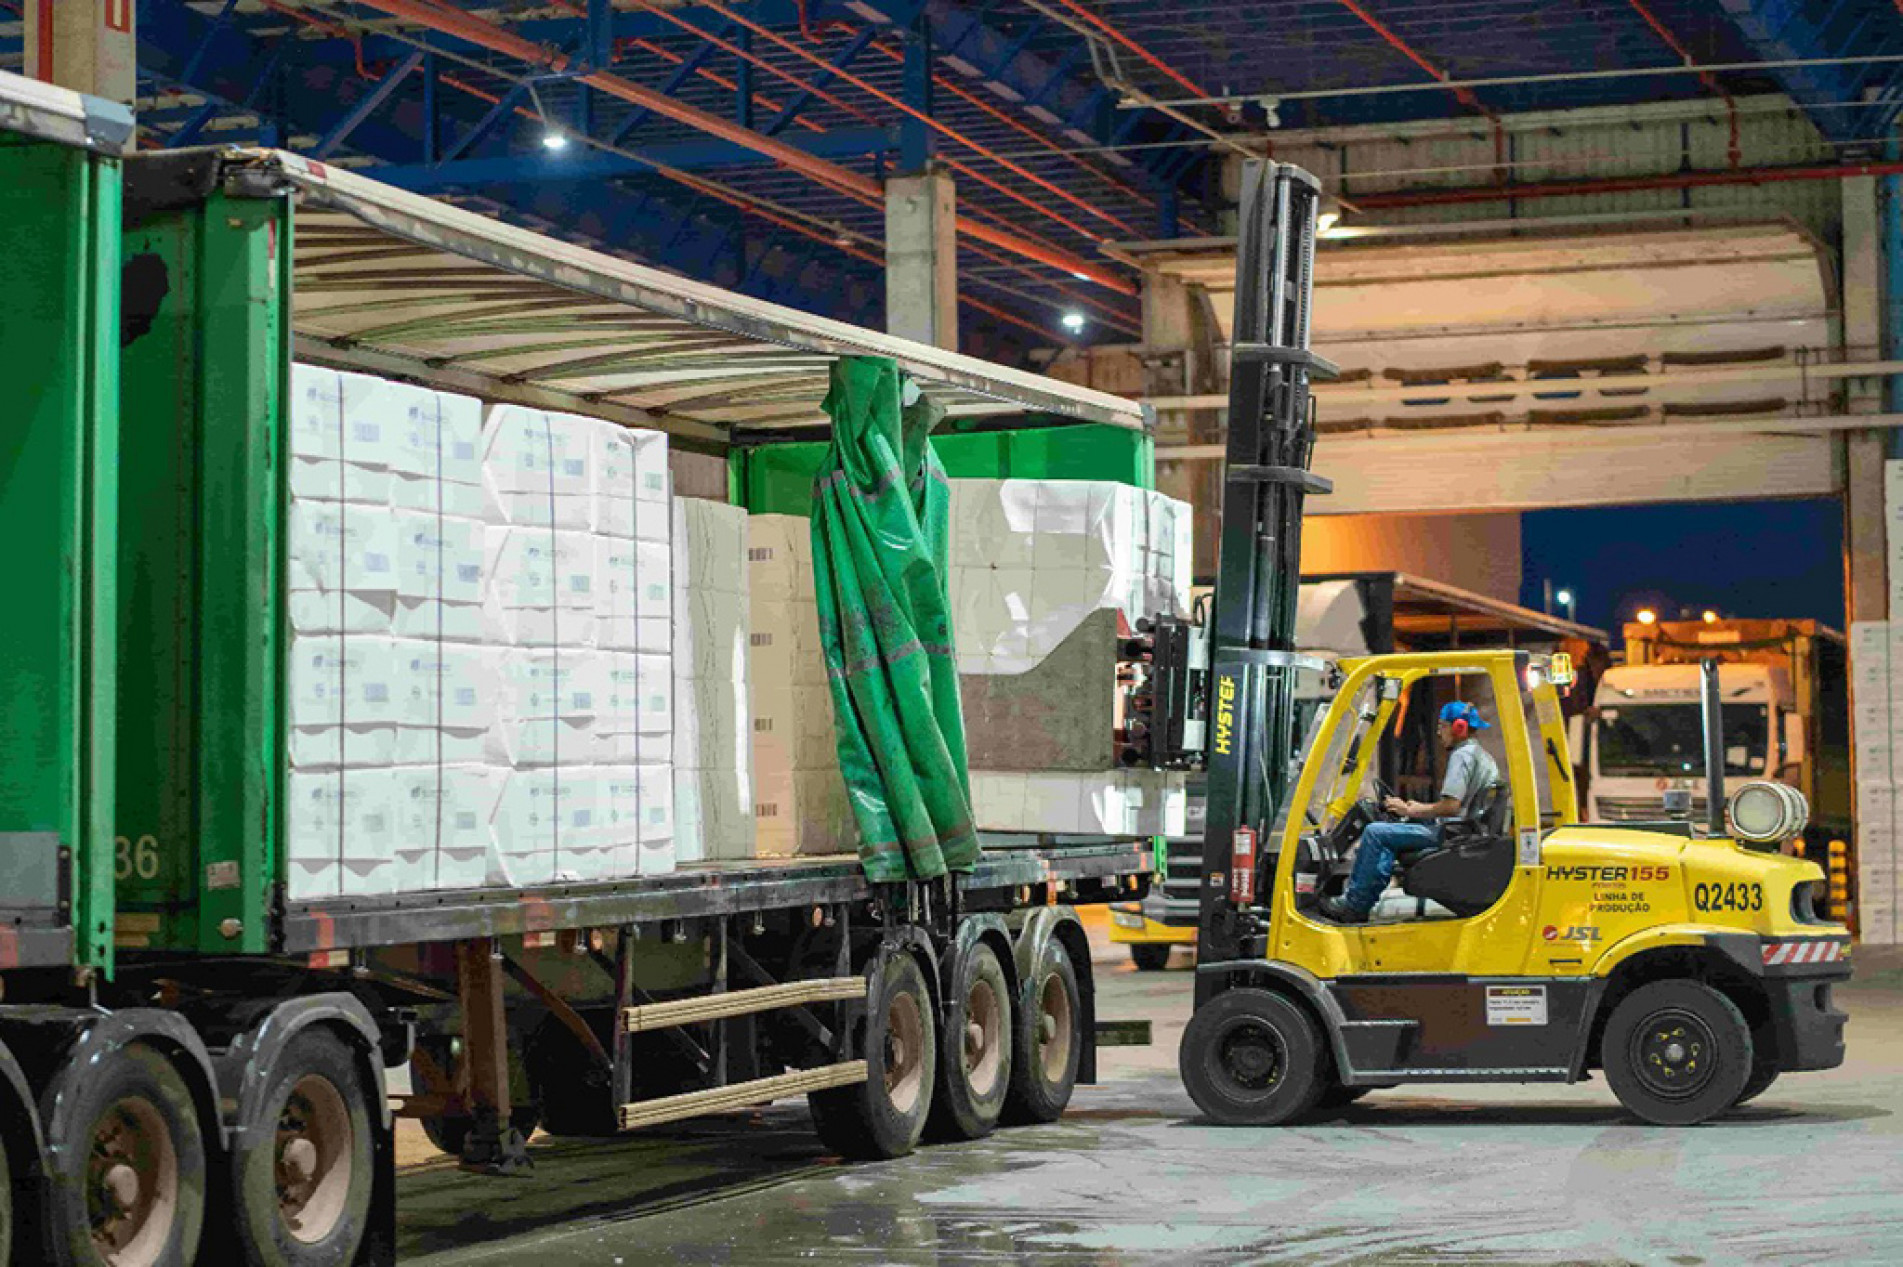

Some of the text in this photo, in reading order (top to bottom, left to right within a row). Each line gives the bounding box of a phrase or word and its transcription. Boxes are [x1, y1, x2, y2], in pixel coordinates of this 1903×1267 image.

[1593, 892, 1645, 902] LINHA DE
[1694, 882, 1763, 913] Q2433
[1589, 901, 1651, 914] PRODUÇÃO
[1560, 926, 1602, 941] JSL
